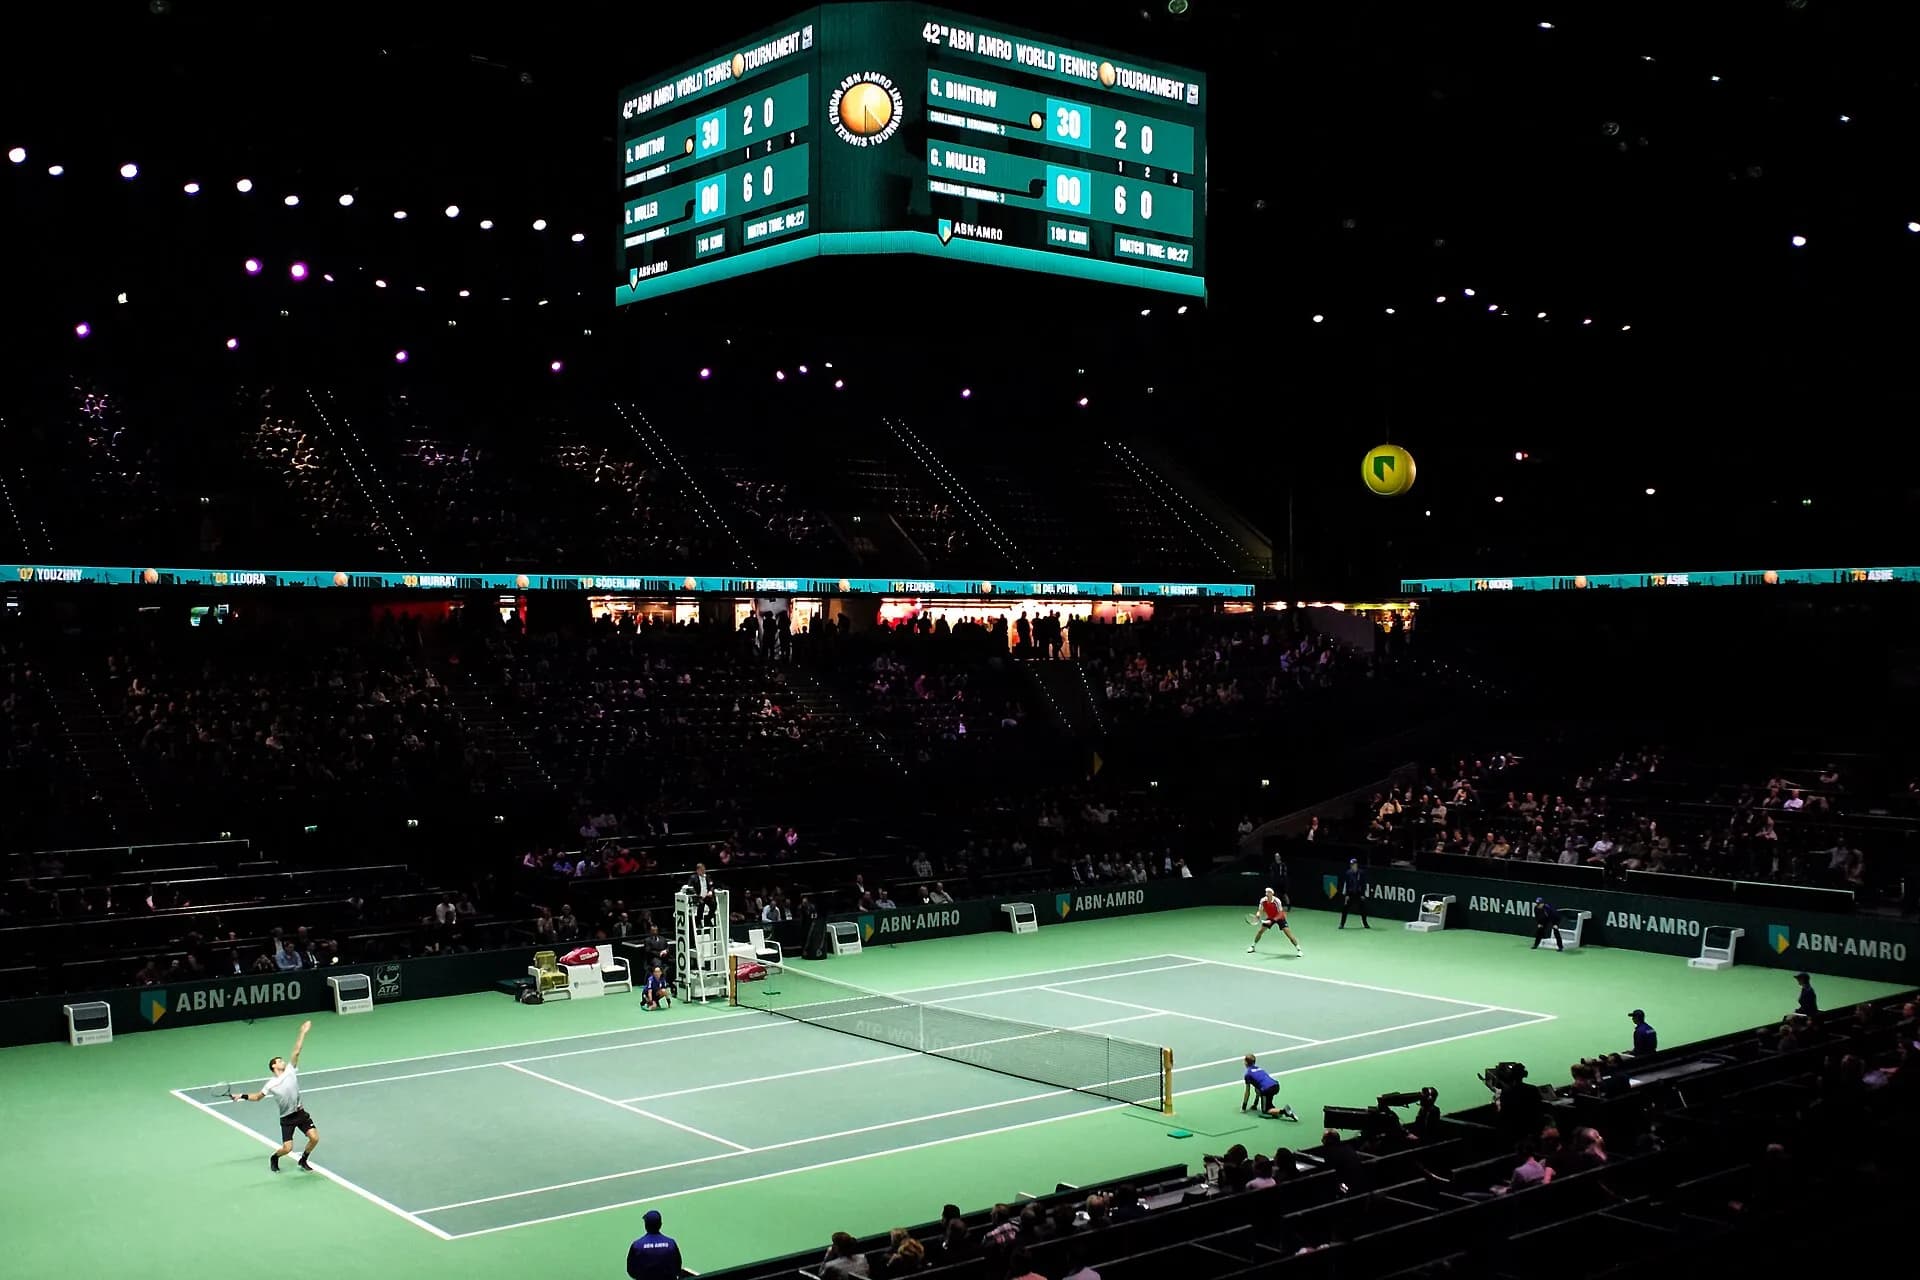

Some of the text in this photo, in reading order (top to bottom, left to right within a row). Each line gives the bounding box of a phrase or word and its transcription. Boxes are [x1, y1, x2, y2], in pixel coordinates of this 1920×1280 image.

[637, 91, 652, 115] ABN
[653, 84, 674, 109] AMRO
[676, 72, 703, 99] WORLD
[704, 59, 732, 88] TENNIS
[743, 31, 801, 72] TOURNAMENT
[841, 71, 893, 91] ABN AMRO
[949, 28, 975, 52] ABN
[977, 34, 1012, 61] AMRO
[1016, 43, 1055, 71] WORLD
[1059, 53, 1099, 81] TENNIS
[1115, 66, 1185, 102] TOURNAMENT
[930, 78, 998, 108] G. DIMITROV
[743, 97, 774, 136] 2 0
[829, 87, 904, 148] WORLD TENNIS TOURNAMENT
[1056, 107, 1081, 140] 30
[702, 117, 720, 150] 30
[746, 131, 795, 159] 1 2 3
[1114, 119, 1153, 155] 2 0
[930, 148, 986, 175] G. MULLER
[1118, 160, 1178, 184] 1 2 3
[702, 183, 719, 216] 00
[743, 165, 774, 203] 6 0
[1056, 173, 1081, 207] 00
[1114, 185, 1153, 220] 6 0
[1119, 238, 1145, 255] MATCH
[1146, 242, 1166, 259] TIME:
[36, 568, 82, 581] YOUZHNY
[230, 573, 266, 585] LLODRA
[419, 575, 457, 587] MURRAY
[905, 582, 936, 593] FEDERER
[676, 909, 687, 990] RICOH
[377, 984, 399, 994] ATP
